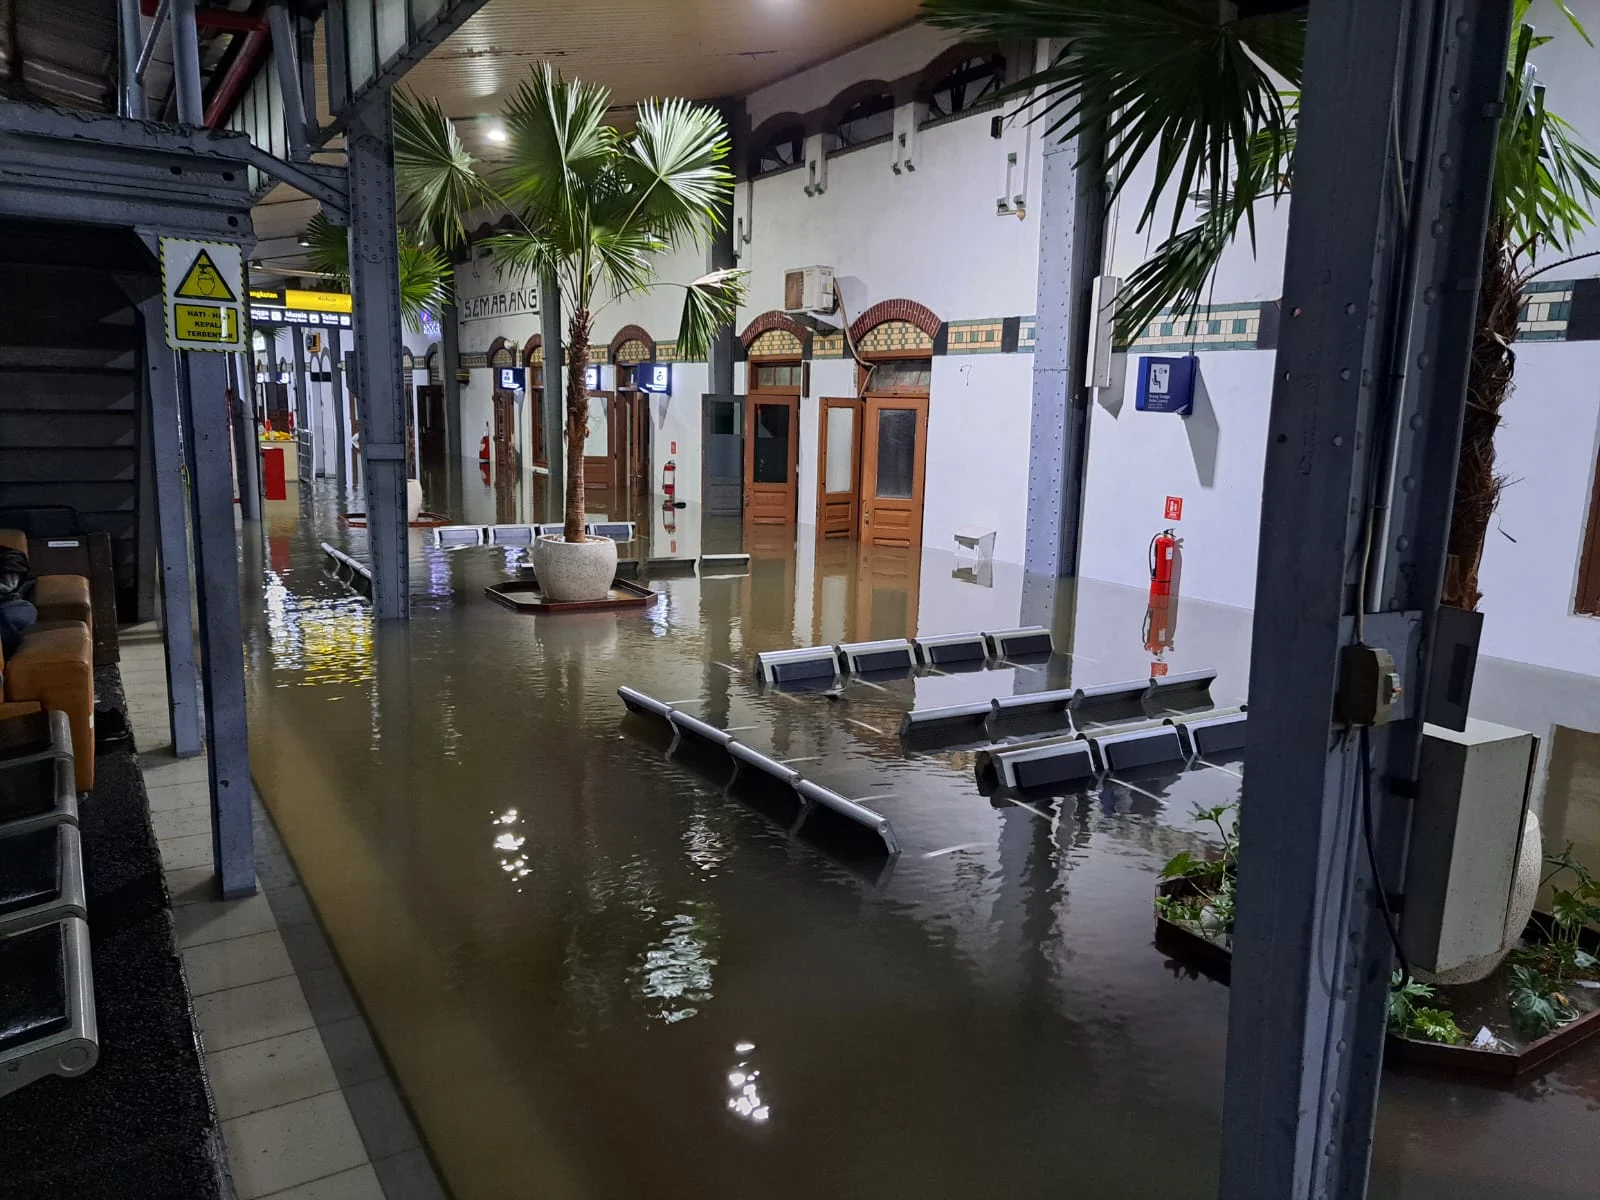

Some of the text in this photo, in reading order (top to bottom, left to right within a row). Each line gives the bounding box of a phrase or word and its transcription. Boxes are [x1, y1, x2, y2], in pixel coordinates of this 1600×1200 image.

[464, 288, 538, 318] SEMARANG
[187, 310, 206, 318] HATI
[187, 330, 233, 339] TERBENTR
